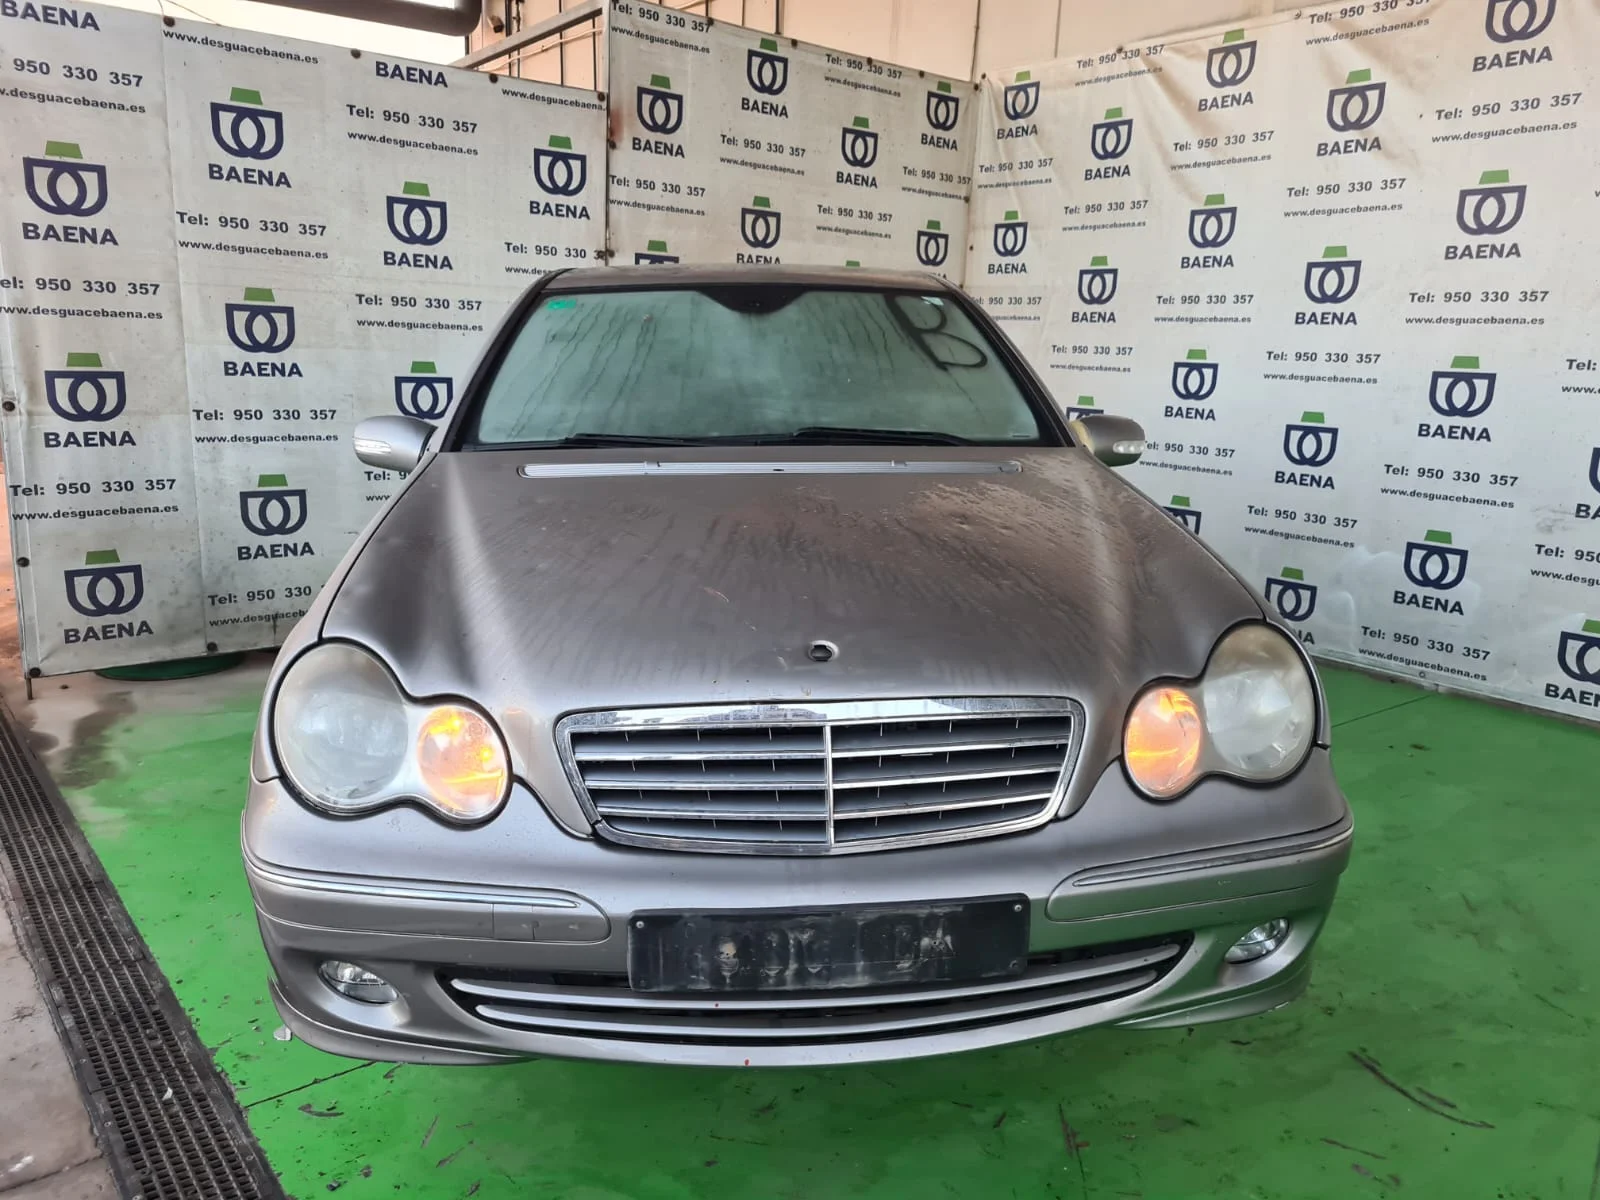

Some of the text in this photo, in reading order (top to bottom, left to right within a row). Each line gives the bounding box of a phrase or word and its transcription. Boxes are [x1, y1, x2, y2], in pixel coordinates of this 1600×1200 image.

[0, 0, 100, 31] BAENA
[611, 0, 711, 33] Tel: 950 330 357
[1309, 12, 1332, 24] Tel:
[1340, 5, 1364, 19] 950
[1373, 0, 1398, 12] 330
[1306, 18, 1430, 45] www.desguacebaena.es
[163, 30, 318, 64] www.desguacebaena.es
[1473, 46, 1552, 72] BAENA
[14, 59, 143, 87] 950 330 357
[376, 61, 448, 88] BAENA
[502, 88, 606, 111] www.desguacebaena.
[742, 97, 788, 118] BAENA
[1198, 92, 1253, 112] BAENA
[1436, 93, 1582, 120] Tel: 950 330 357
[346, 104, 477, 133] Tel: 950 330 357
[997, 124, 1038, 139] BAENA
[1174, 131, 1274, 151] Tel: 950 330 357
[1432, 122, 1577, 143] www.desguacebaena.es
[347, 131, 479, 156] www.desguacebaena.es
[632, 137, 684, 158] BAENA
[721, 134, 805, 157] Tel: 950 330 357
[921, 133, 957, 151] BAENA
[1317, 137, 1381, 156] BAENA
[209, 164, 291, 188] BAENA
[837, 171, 877, 188] BAENA
[1085, 165, 1130, 180] BAENA
[610, 175, 705, 197] Tel: 950 330 357
[1287, 178, 1406, 197] Tel: 950 330 357
[530, 201, 590, 220] BAENA
[1064, 200, 1148, 215] Tel: 950 330 357
[1284, 204, 1402, 217] www.desguacebaena.es
[176, 211, 326, 236] Tel: 950 330 357
[22, 223, 118, 245] BAENA
[178, 240, 328, 259] www.desguacebaena.es
[505, 242, 586, 258] Tel: 950 330
[1445, 243, 1521, 260] BAENA
[384, 251, 453, 270] BAENA
[988, 263, 1027, 274] BAENA
[1181, 255, 1234, 268] BAENA
[0, 277, 160, 295] el: 950 330 357
[355, 294, 482, 310] Tel: 950 330 357
[1157, 295, 1254, 304] Tel: 950 330 357
[1409, 291, 1549, 303] Tel: 950 330 357
[0, 306, 163, 319] ww.desguacebaena.es
[1072, 312, 1116, 323] BAENA
[1295, 312, 1357, 325] BAENA
[1405, 316, 1544, 326] www.desguacebaena.es
[357, 320, 483, 331] www.desguacebaena.es
[1052, 345, 1133, 355] Tel: 950 330 357
[1267, 351, 1381, 363] Tel: 950 330 357
[224, 362, 303, 377] BAENA
[1566, 359, 1596, 371] Tel:
[192, 409, 336, 420] Tel: 950 330 357
[1165, 406, 1215, 420] BAENA
[44, 431, 136, 448] BAENA
[195, 434, 338, 444] www.desguacebaena.es
[1418, 424, 1491, 442] BAENA
[1165, 443, 1235, 458] 950 330 357
[364, 471, 390, 481] Tel:
[1275, 471, 1334, 489] BAENA
[1384, 464, 1518, 486] Tel: 950 330 357
[9, 479, 176, 496] Tel: 950 330 357
[1381, 488, 1514, 508] www.desguacebaena.es
[12, 505, 179, 520] www.desguacebaena.es
[1248, 505, 1357, 528] Tel: 950 330 357
[238, 542, 314, 560] BAENA
[1535, 544, 1564, 558] Tel:
[208, 593, 237, 606] Tel:
[247, 589, 275, 601] 950
[285, 586, 311, 598] 330
[1393, 591, 1464, 615] BAENA
[64, 621, 153, 644] BAENA
[1361, 626, 1490, 660] Tel: 950 330 357
[1358, 647, 1487, 681] www.desguacebaena.es
[1545, 683, 1600, 707] BAE
